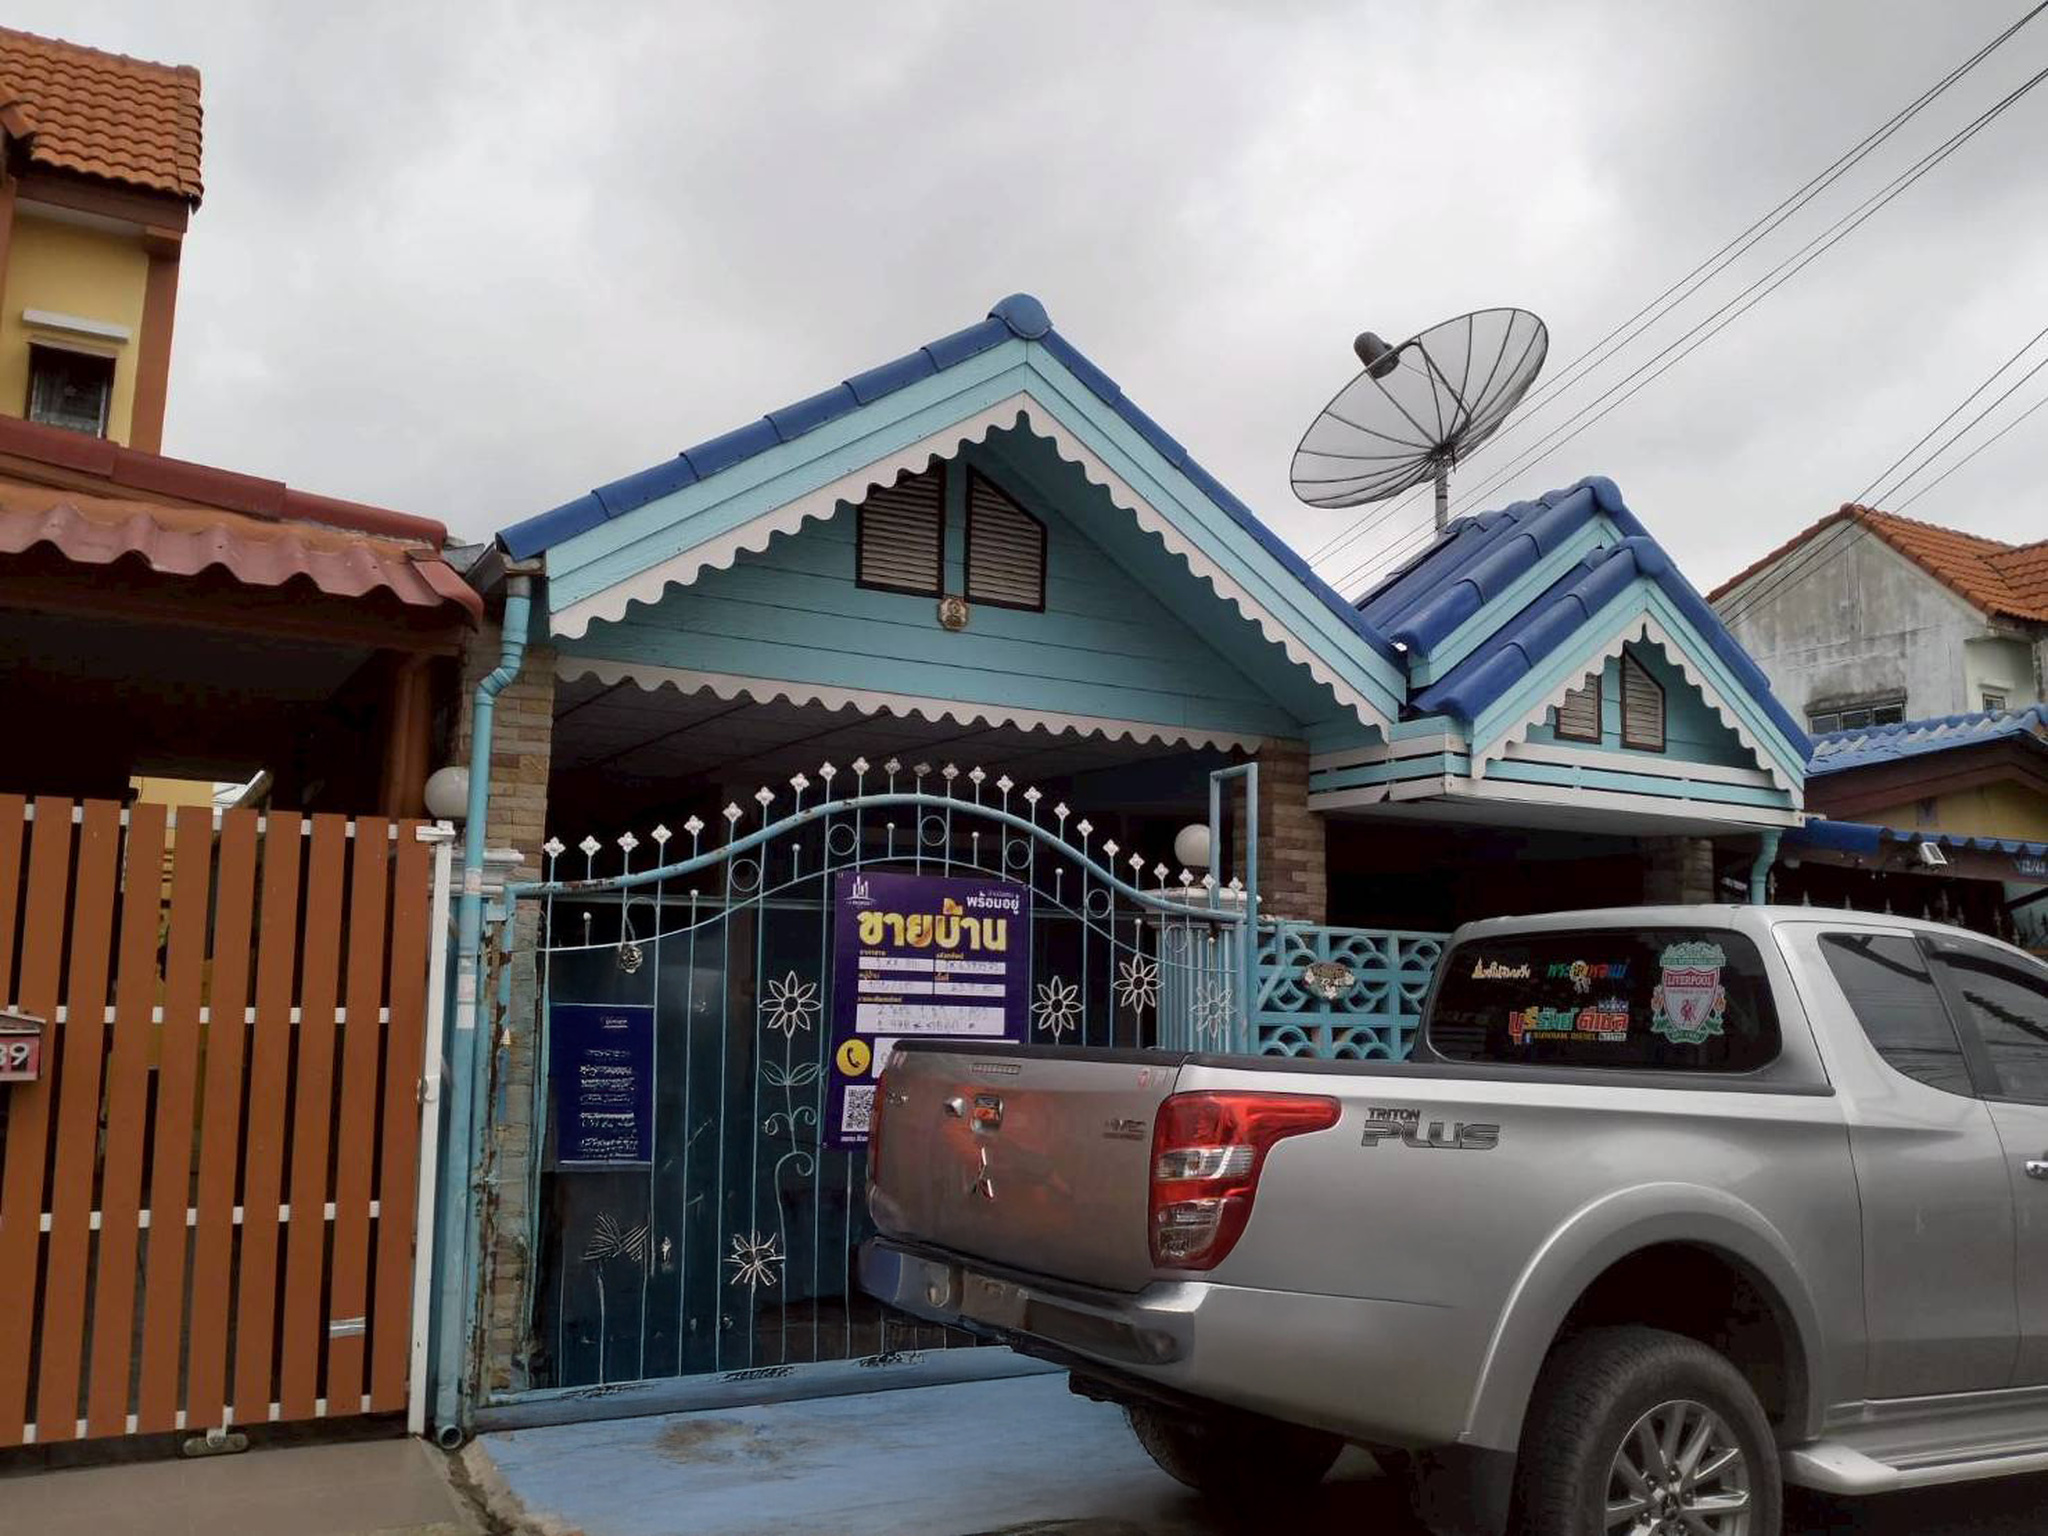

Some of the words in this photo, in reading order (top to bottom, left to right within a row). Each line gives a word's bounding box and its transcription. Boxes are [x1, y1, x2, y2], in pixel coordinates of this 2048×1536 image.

[966, 891, 1020, 915] พร้อมอยู่
[856, 897, 1007, 952] ขายบ้าน
[1667, 974, 1713, 987] LIVERPOOL
[1368, 1107, 1420, 1120] TRITON
[1361, 1119, 1500, 1150] PLUS
